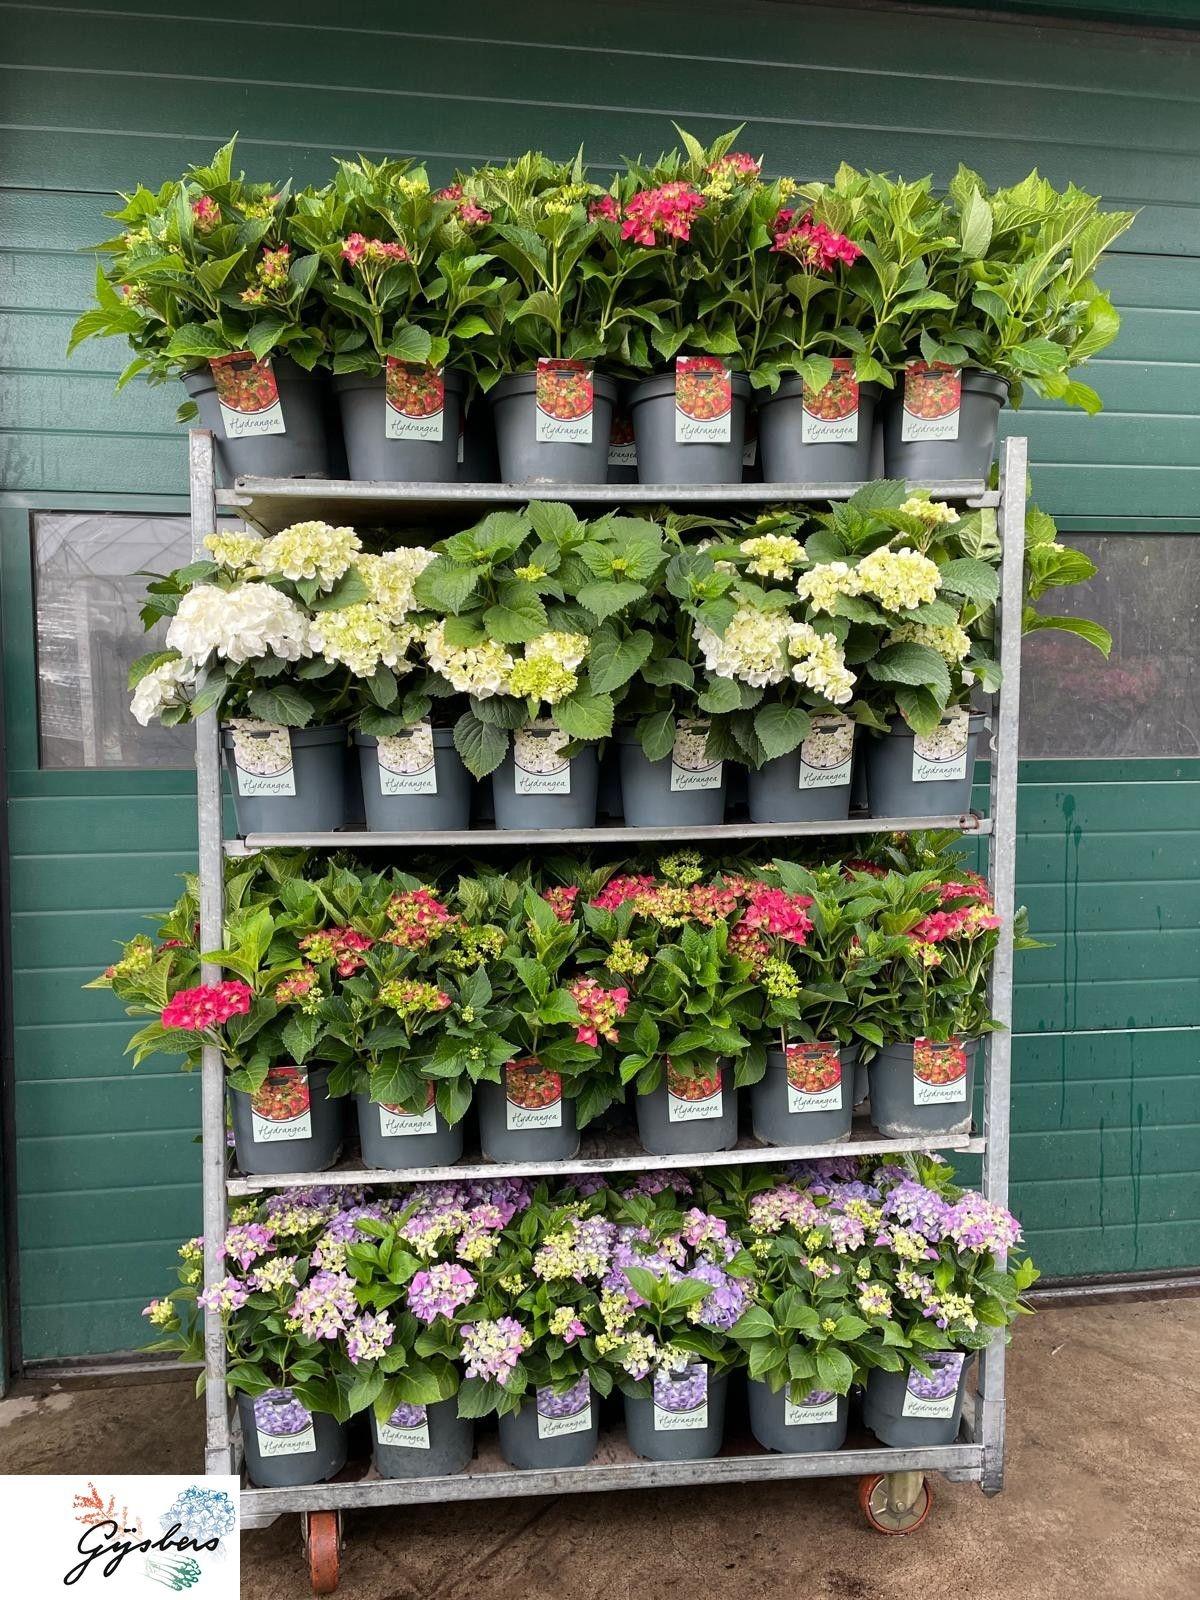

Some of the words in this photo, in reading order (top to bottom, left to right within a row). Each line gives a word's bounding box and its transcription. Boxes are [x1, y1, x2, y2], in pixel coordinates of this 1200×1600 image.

[229, 417, 280, 435] Hydrangea
[391, 419, 439, 438] Hydrangea
[541, 422, 589, 439] Hydrangea
[680, 422, 727, 439] Hydrangea
[807, 423, 854, 440] Hydrangea
[907, 422, 955, 438] Hydrangea
[803, 771, 847, 787] Hydrangea
[917, 763, 962, 779] Hydrangea
[242, 777, 291, 794] Hydrangea
[384, 777, 433, 793] Hydrangea
[519, 775, 567, 793] Hydrangea
[675, 773, 718, 789] Hydrangea
[793, 1095, 839, 1110] Hydrangea
[918, 1088, 964, 1103] Hydrangea
[673, 1103, 719, 1119] Hydrangea
[385, 1119, 432, 1134] Hydrangea
[511, 1112, 559, 1128] Hydrangea
[258, 1124, 307, 1140] Hydrangea
[908, 1400, 950, 1416] Hydrangea
[658, 1414, 704, 1429] Hydrangea
[789, 1409, 834, 1425] Hydrangea
[543, 1418, 587, 1435] Hydrangea
[381, 1429, 427, 1445] Hydrangea
[263, 1439, 312, 1454] Hydrangea
